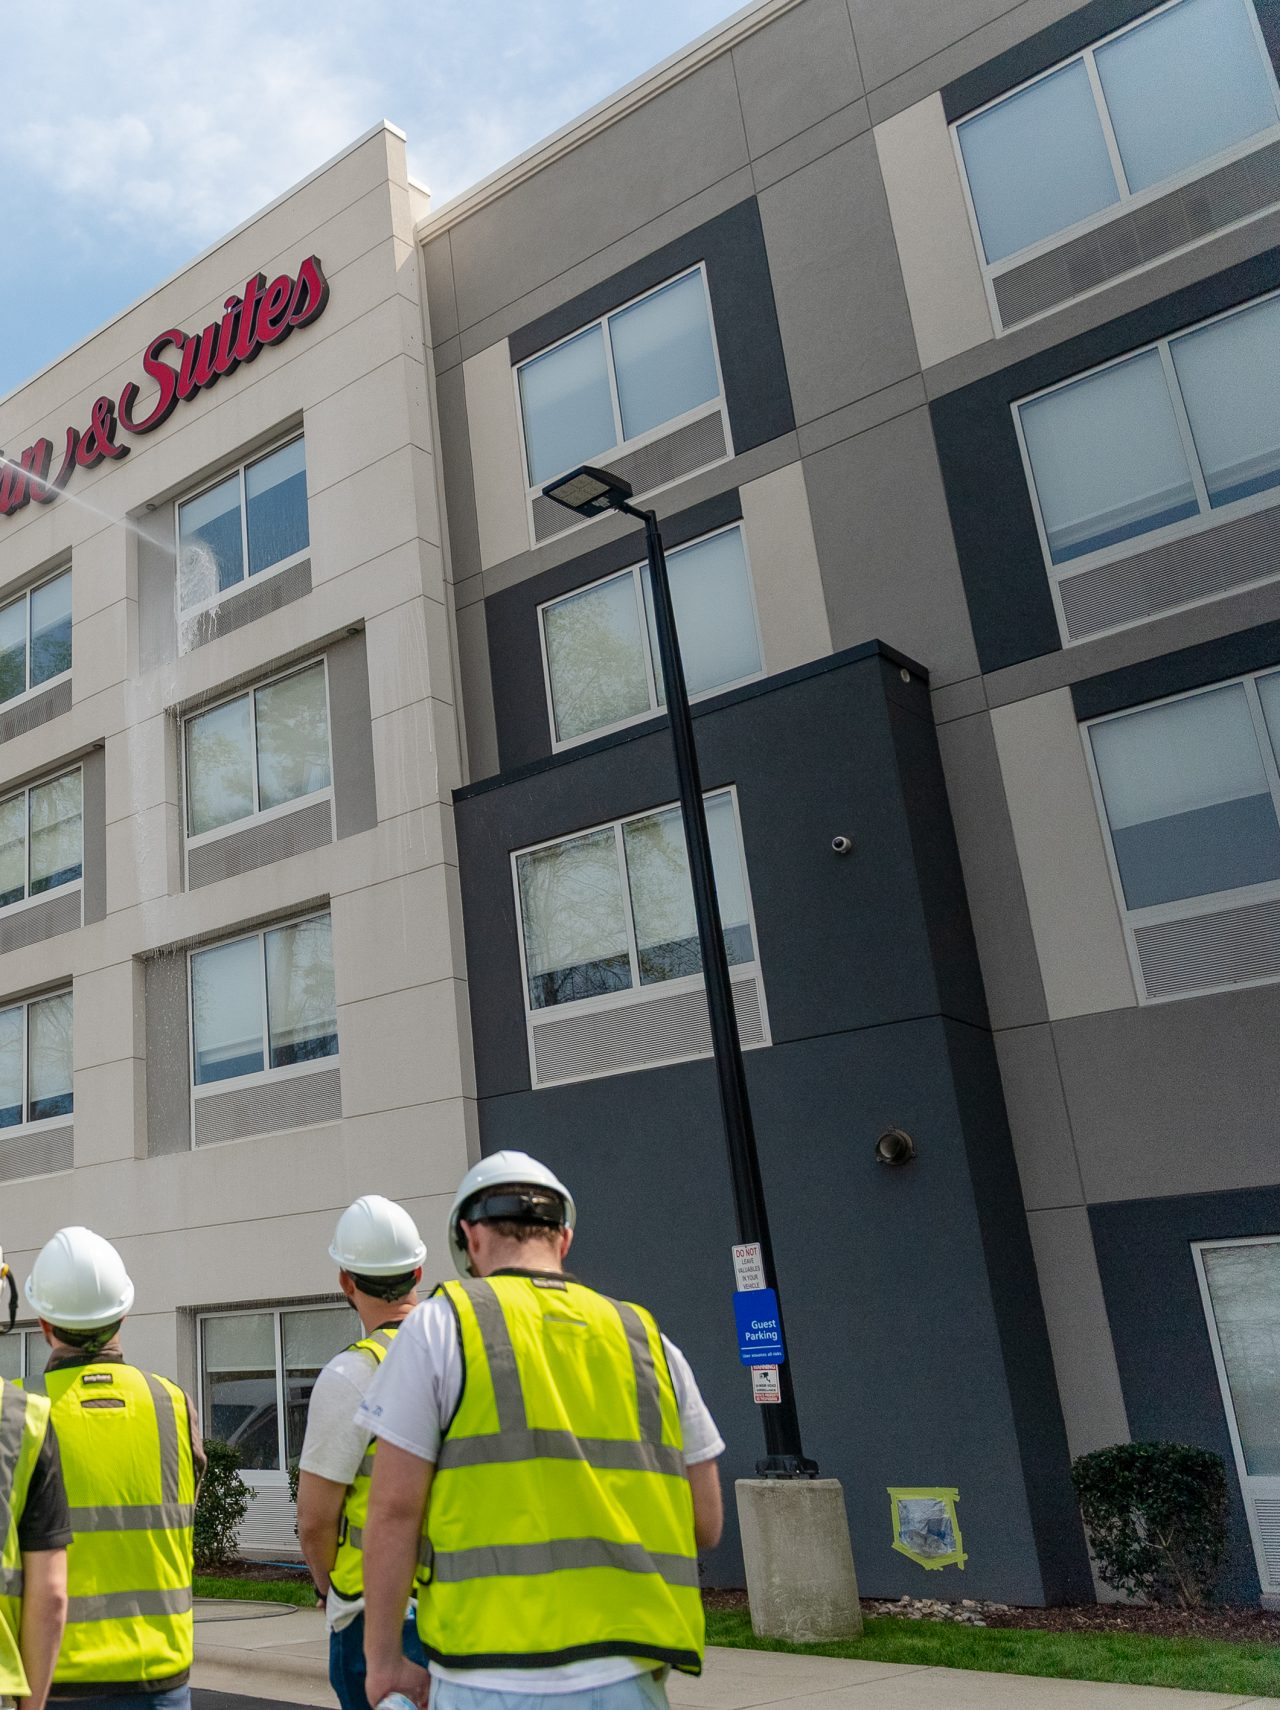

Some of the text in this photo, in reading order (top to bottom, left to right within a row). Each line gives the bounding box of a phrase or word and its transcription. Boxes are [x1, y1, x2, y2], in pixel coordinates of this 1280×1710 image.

[75, 396, 131, 468] &
[119, 254, 330, 434] Suites
[735, 1247, 758, 1258] DO NOT
[741, 1257, 755, 1265] LEAVE
[738, 1265, 761, 1274] VALUABLES
[743, 1282, 761, 1290] VEHICLE
[751, 1319, 777, 1330] Guest
[745, 1330, 778, 1342] Parking
